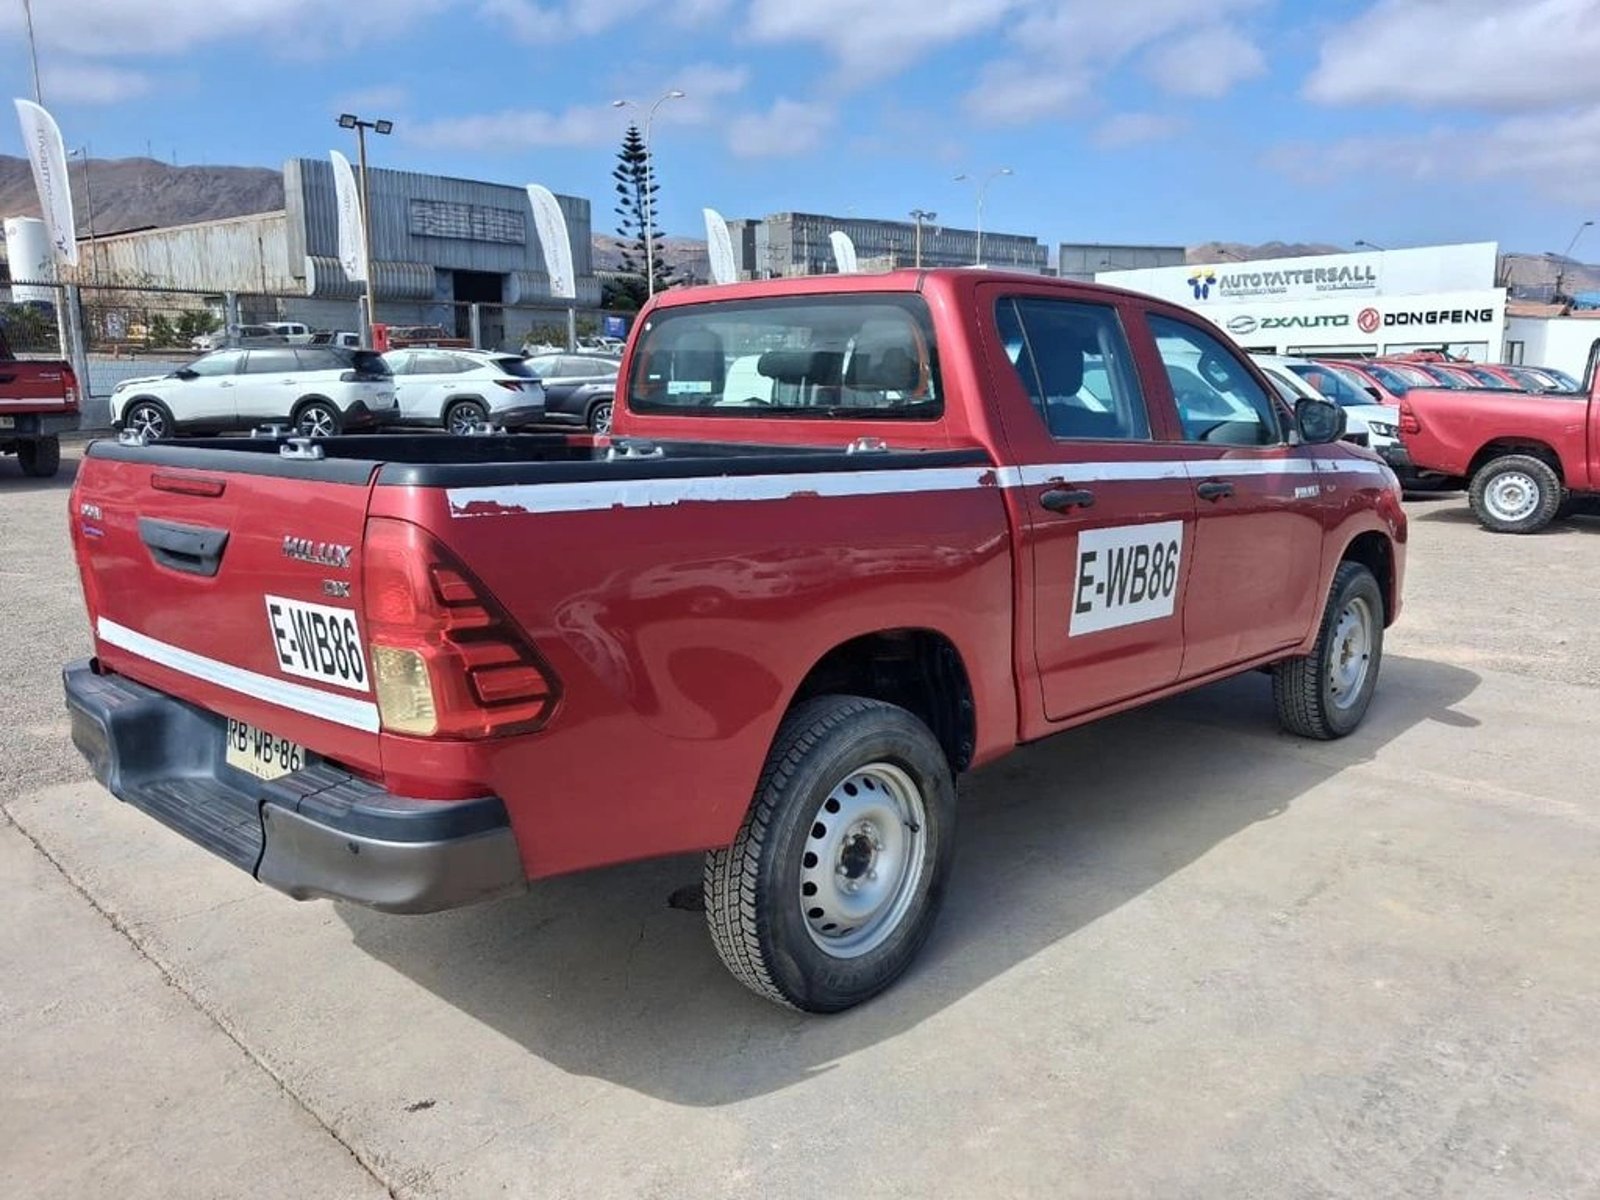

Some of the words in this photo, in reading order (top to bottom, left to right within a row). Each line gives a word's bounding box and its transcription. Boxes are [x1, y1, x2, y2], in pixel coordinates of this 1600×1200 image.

[1260, 314, 1350, 330] ZXAUTO
[1383, 308, 1493, 326] DONGFENG
[1074, 538, 1179, 615] E-WB86
[269, 602, 364, 684] E-WB86
